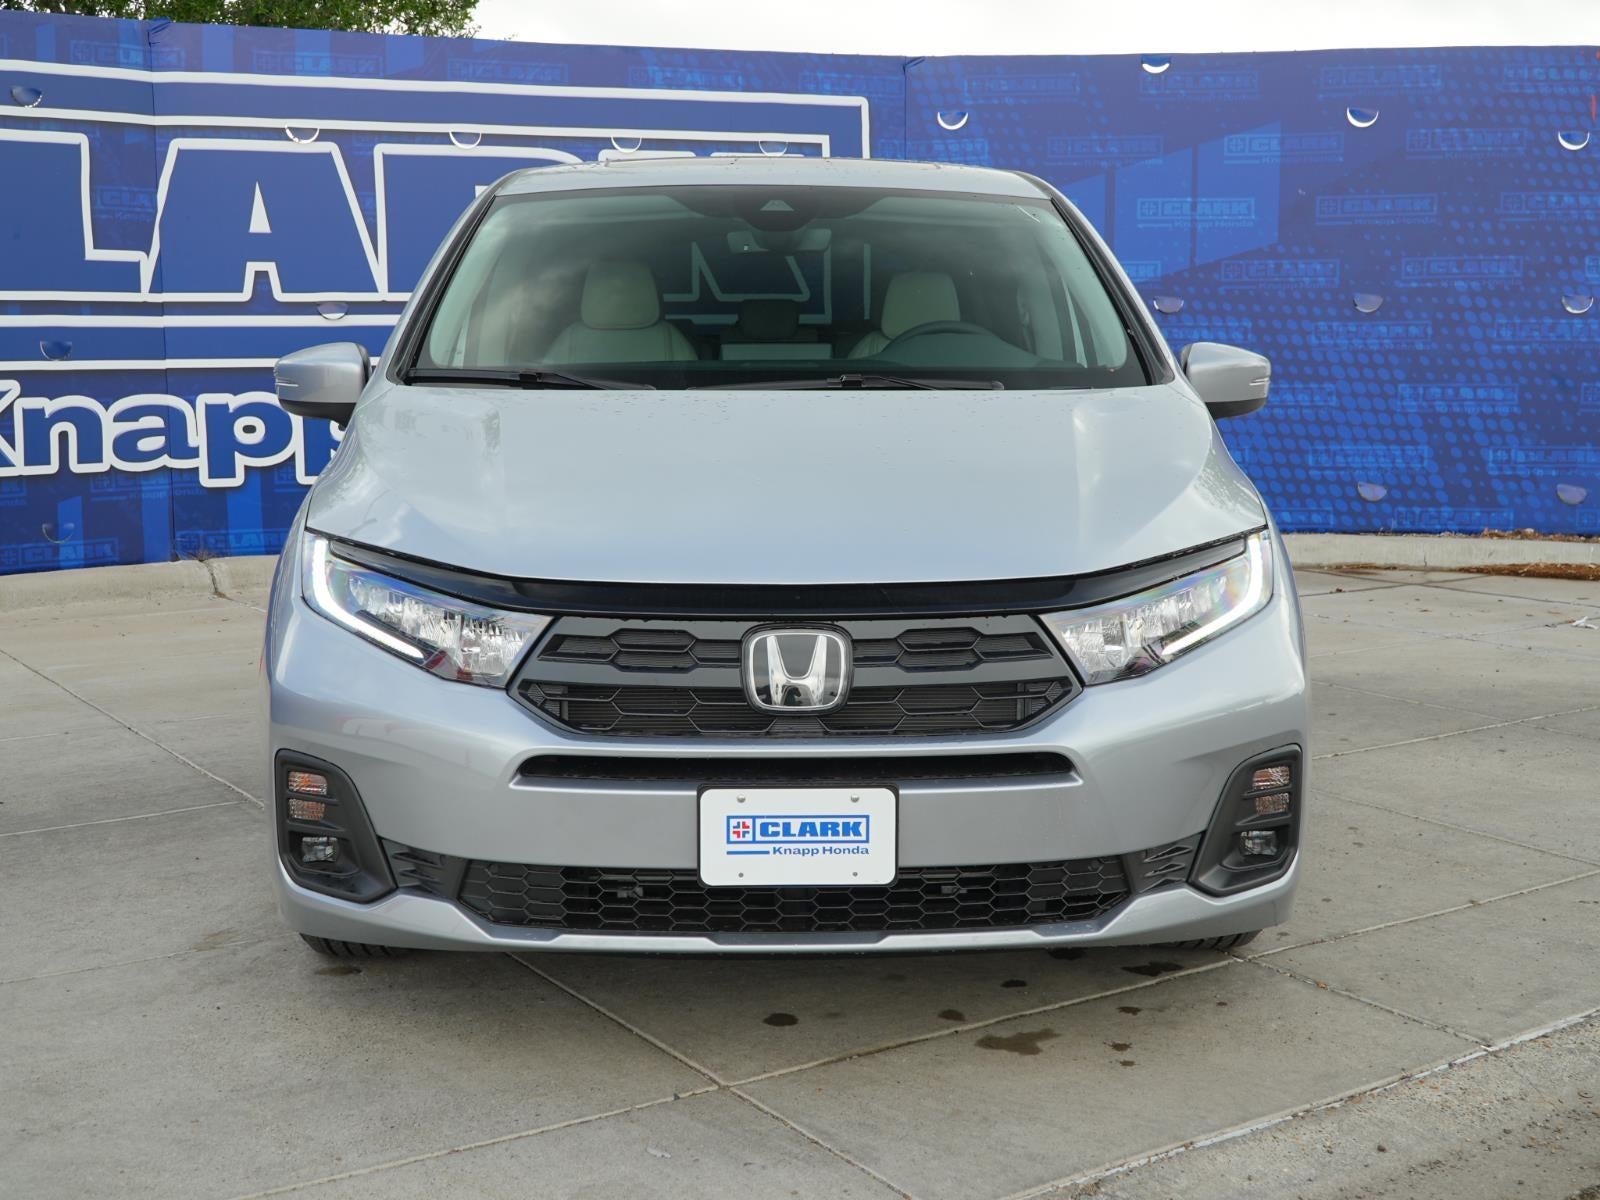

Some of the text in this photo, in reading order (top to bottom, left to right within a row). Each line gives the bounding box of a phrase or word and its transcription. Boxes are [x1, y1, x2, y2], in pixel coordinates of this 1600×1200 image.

[1162, 201, 1249, 216] CLARK
[759, 821, 863, 837] CLARK
[772, 845, 869, 857] Knapp Honda
